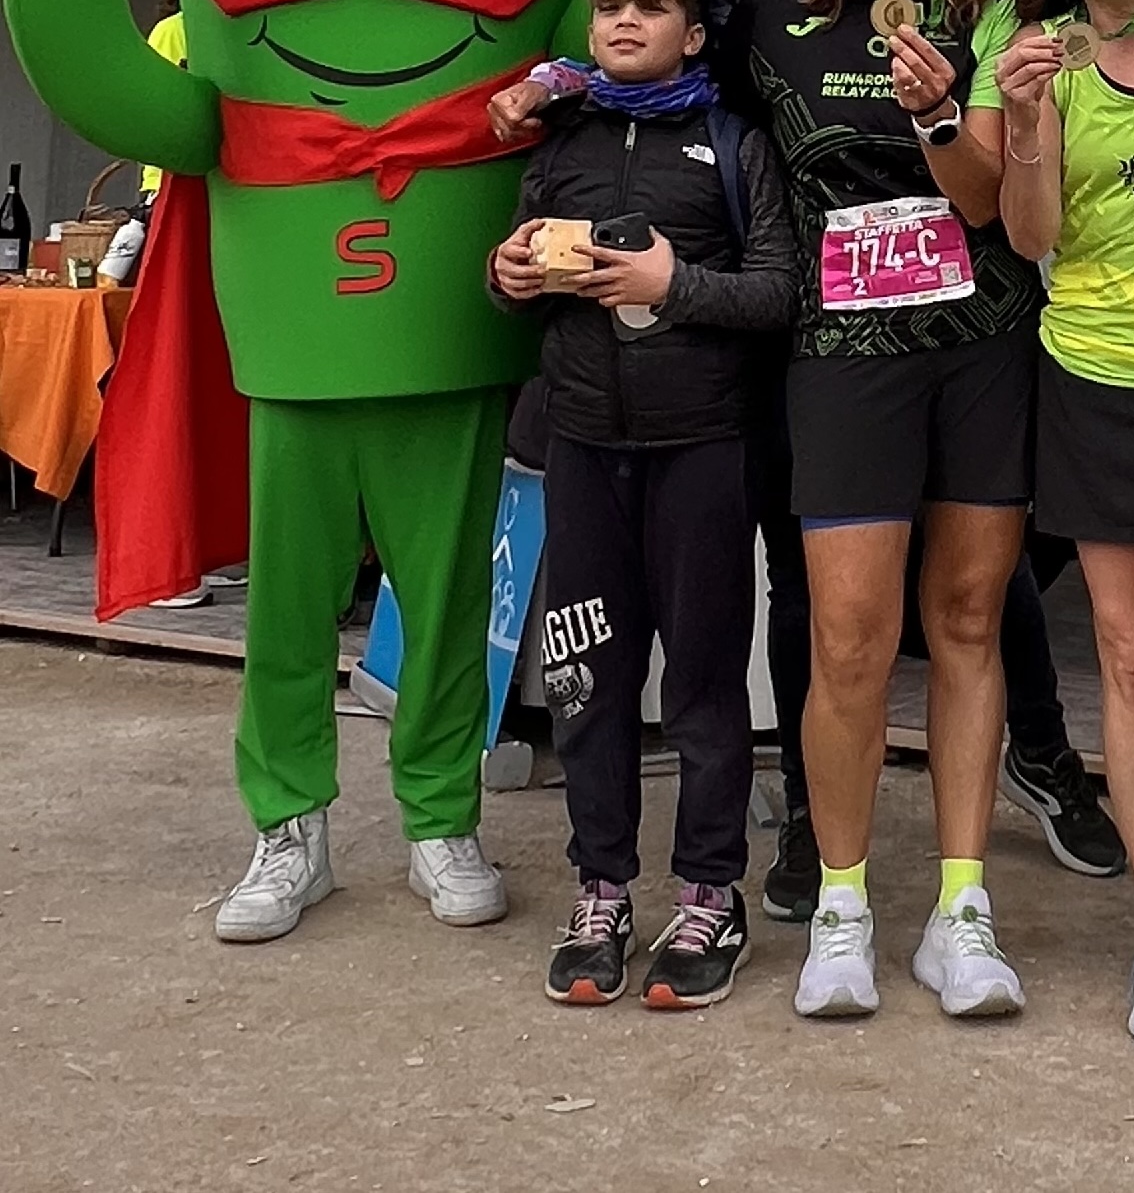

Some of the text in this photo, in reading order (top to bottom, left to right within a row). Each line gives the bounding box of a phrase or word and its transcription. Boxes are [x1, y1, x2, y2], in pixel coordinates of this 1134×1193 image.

[822, 72, 893, 85] RUN4ROM
[821, 85, 898, 99] RELAY RAC
[854, 220, 924, 241] STAFFETTA
[336, 219, 397, 295] S
[843, 228, 941, 278] 774-C
[852, 277, 868, 296] 2
